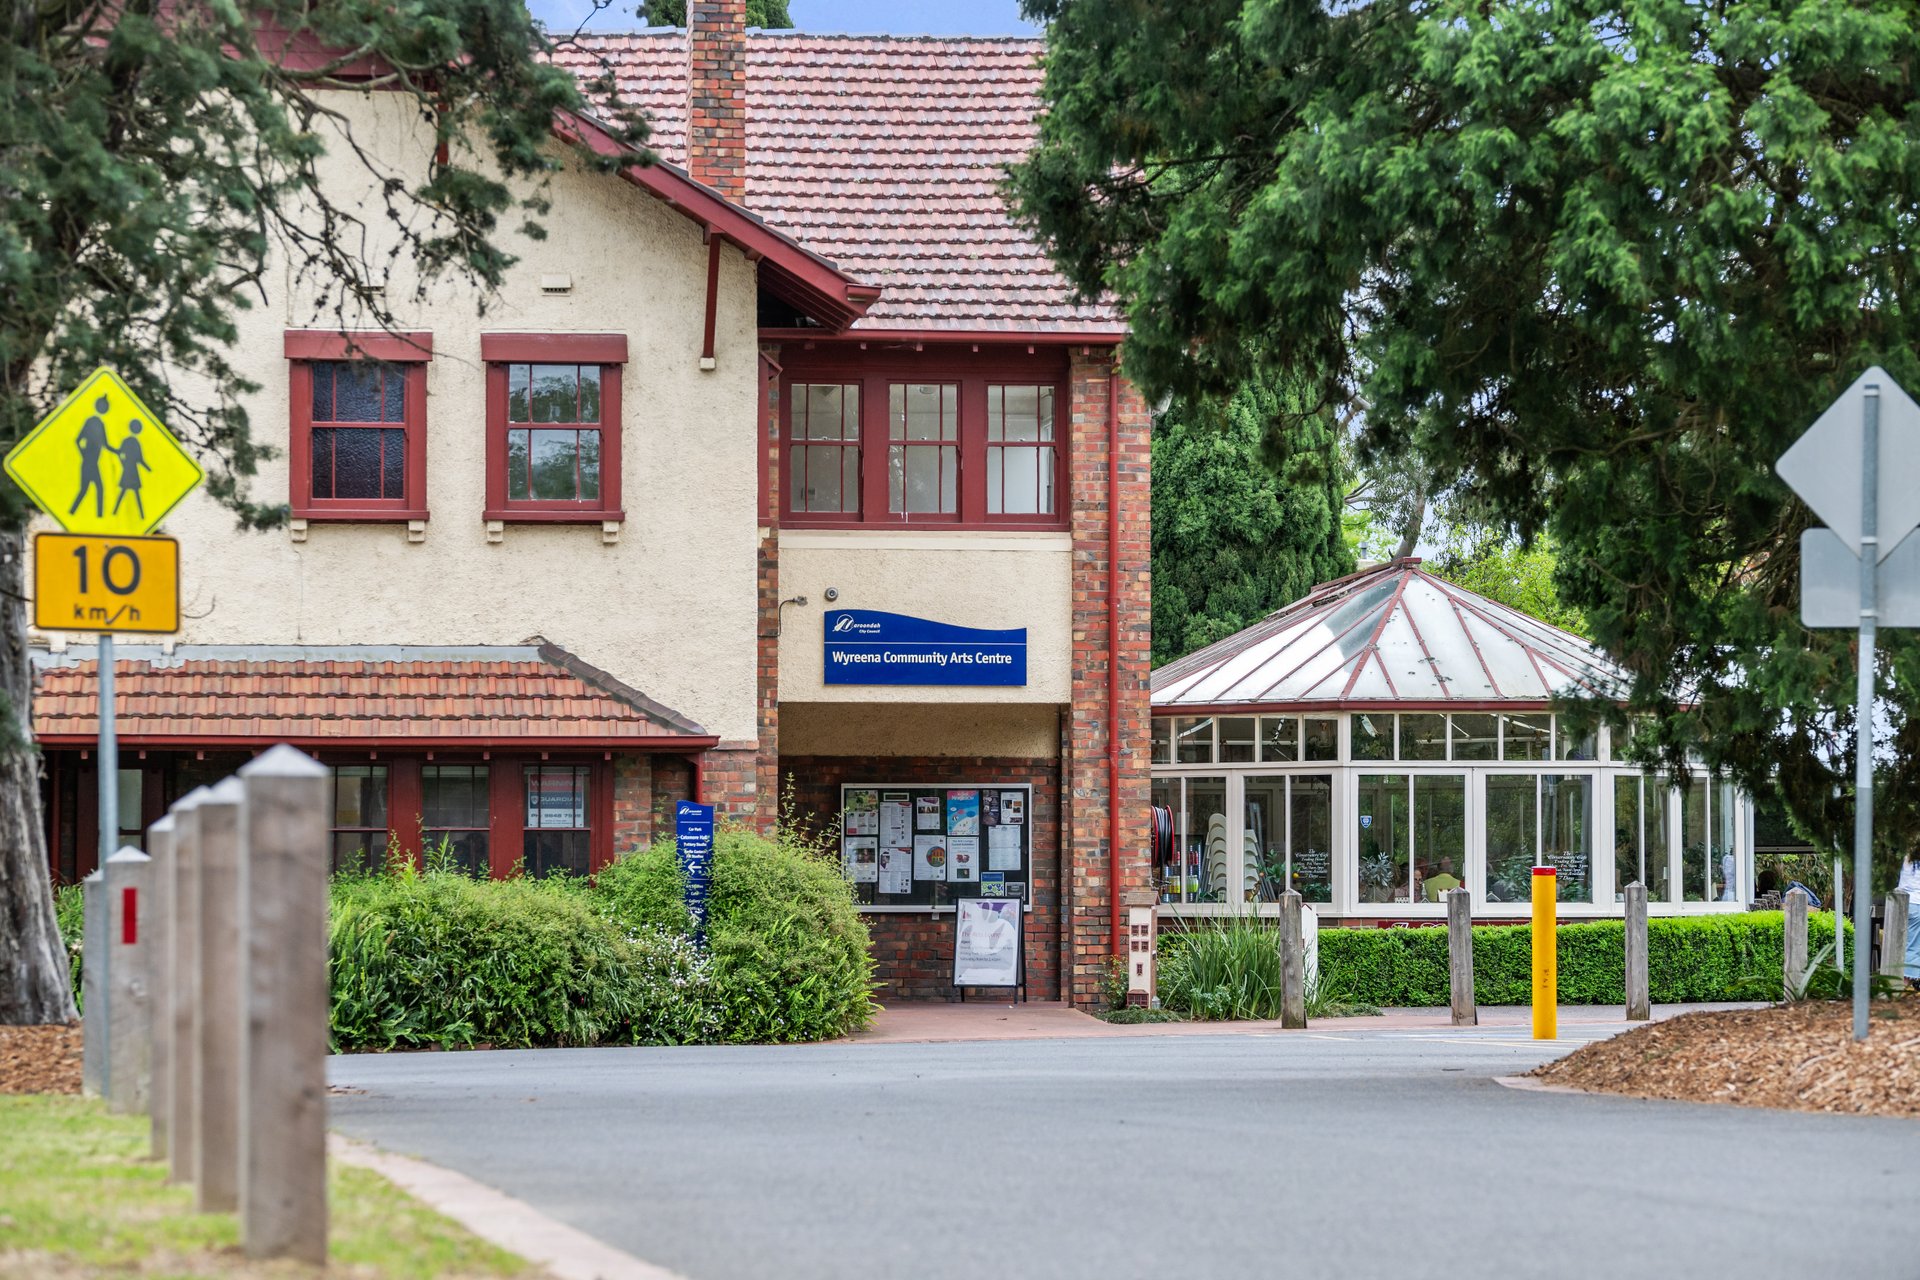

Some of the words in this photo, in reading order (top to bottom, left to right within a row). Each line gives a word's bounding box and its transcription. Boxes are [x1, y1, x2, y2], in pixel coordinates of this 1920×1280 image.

[72, 545, 141, 596] 10
[73, 604, 140, 625] km/h
[832, 651, 881, 666] Wyreena
[884, 651, 948, 666] Community
[950, 652, 973, 664] Arts
[975, 652, 1012, 664] Centre
